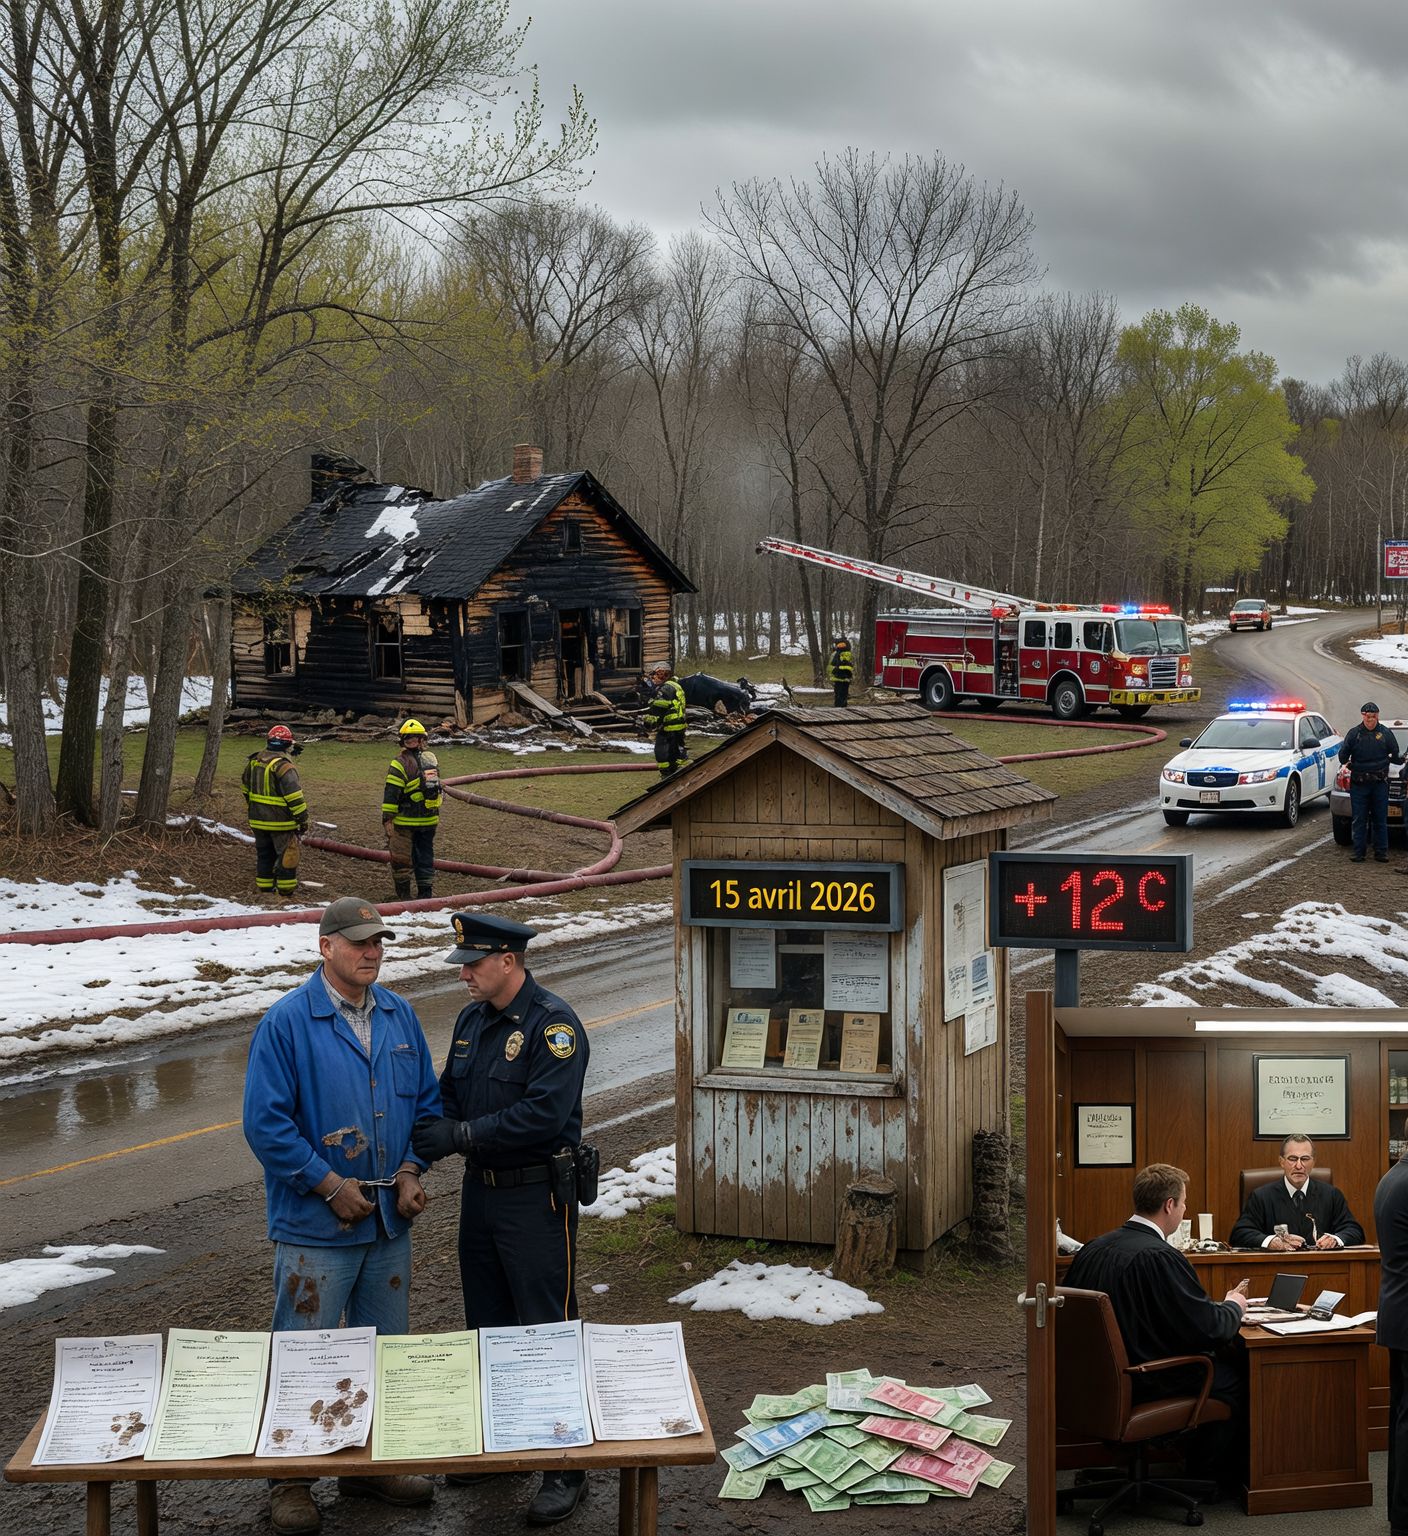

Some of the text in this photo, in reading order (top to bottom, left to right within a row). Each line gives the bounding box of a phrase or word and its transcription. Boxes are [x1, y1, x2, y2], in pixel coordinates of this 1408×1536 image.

[710, 879, 876, 913] 15 avril 2026
